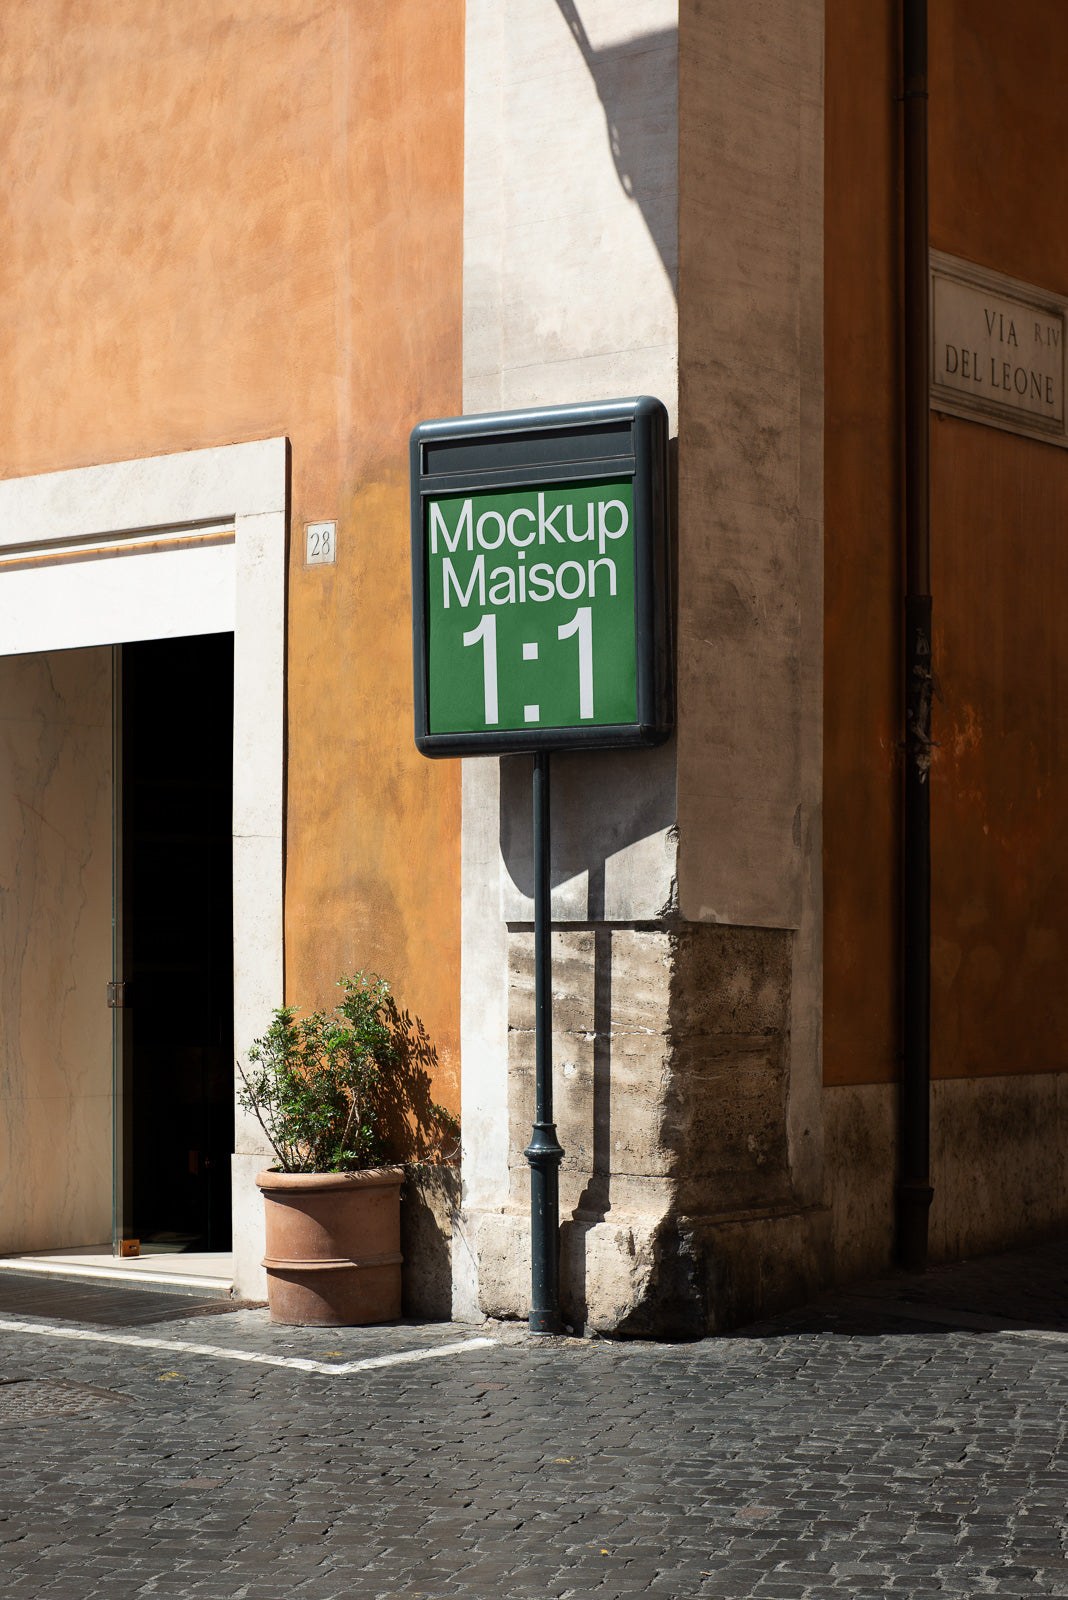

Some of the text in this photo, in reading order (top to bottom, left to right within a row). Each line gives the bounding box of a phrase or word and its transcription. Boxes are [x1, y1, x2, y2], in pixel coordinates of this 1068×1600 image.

[984, 309, 1018, 347] VIA
[945, 344, 1054, 404] DEL LEONE
[310, 530, 330, 556] 28
[430, 492, 629, 554] Mockup
[442, 551, 617, 609] Maison
[463, 606, 594, 725] 1:1
